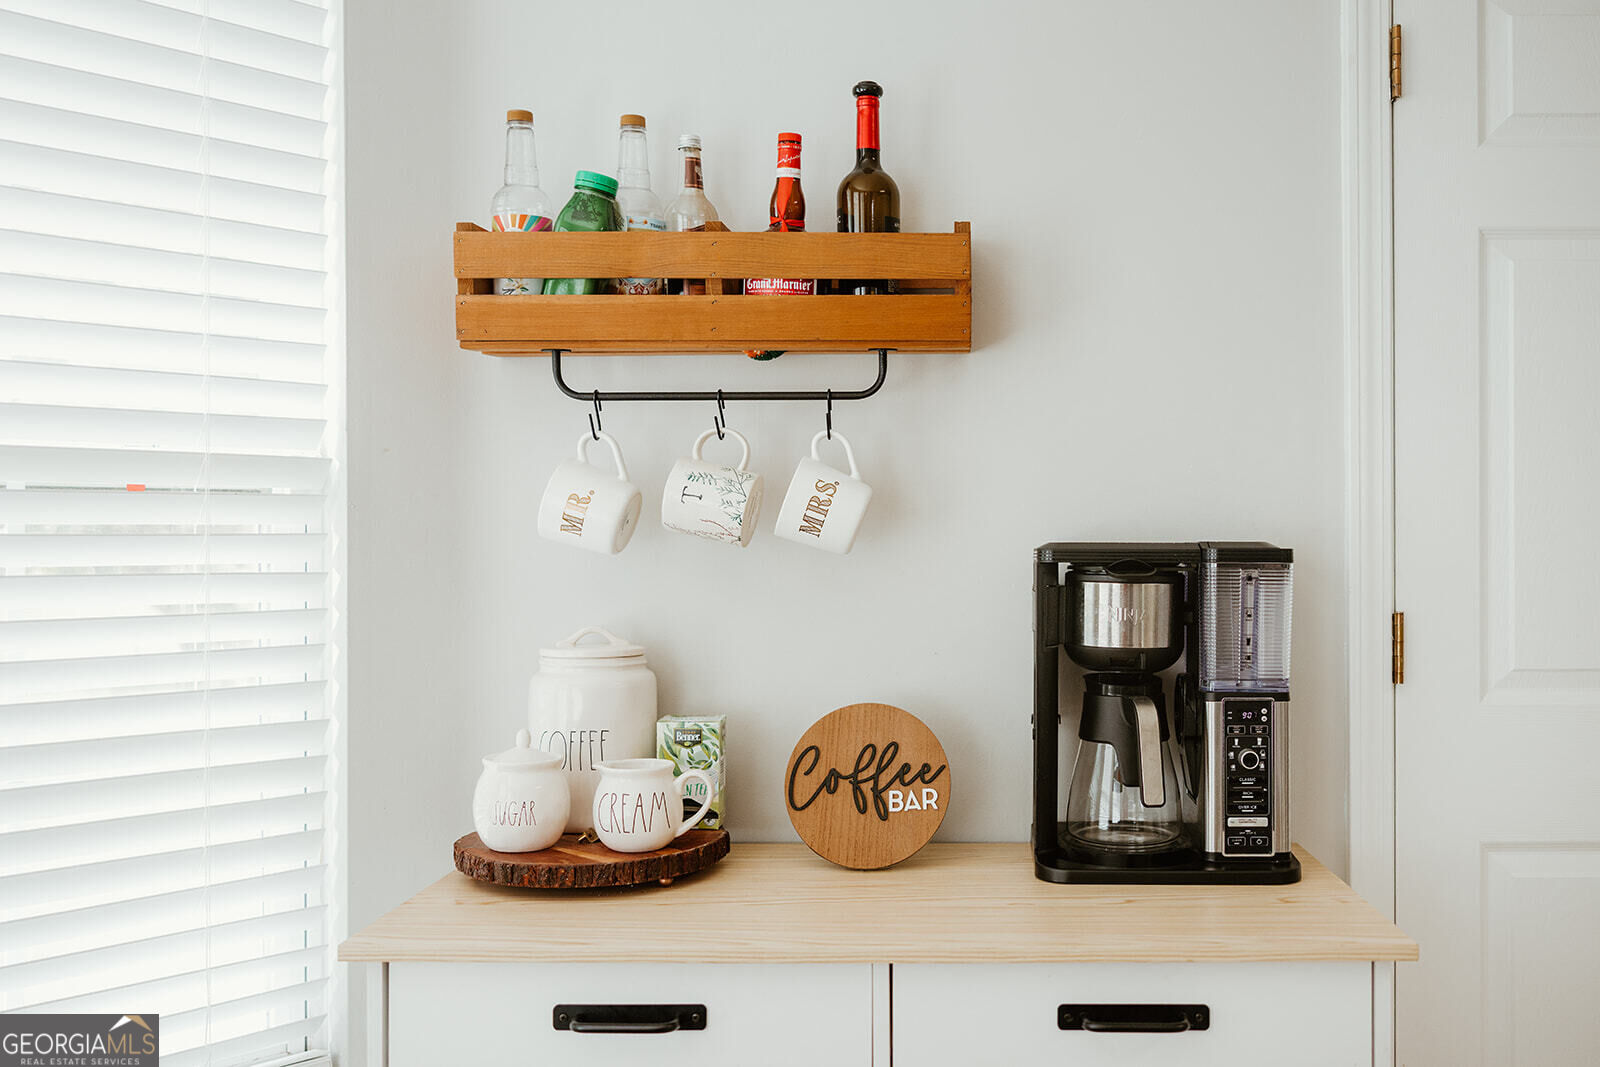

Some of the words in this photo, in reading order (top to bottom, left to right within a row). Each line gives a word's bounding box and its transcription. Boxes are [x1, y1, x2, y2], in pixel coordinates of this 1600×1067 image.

[559, 488, 596, 537] MR.
[799, 478, 840, 539] MRS.
[788, 741, 946, 821] Coffee
[888, 788, 939, 812] BAR
[492, 800, 537, 827] SUGAR
[599, 791, 671, 834] CREAM
